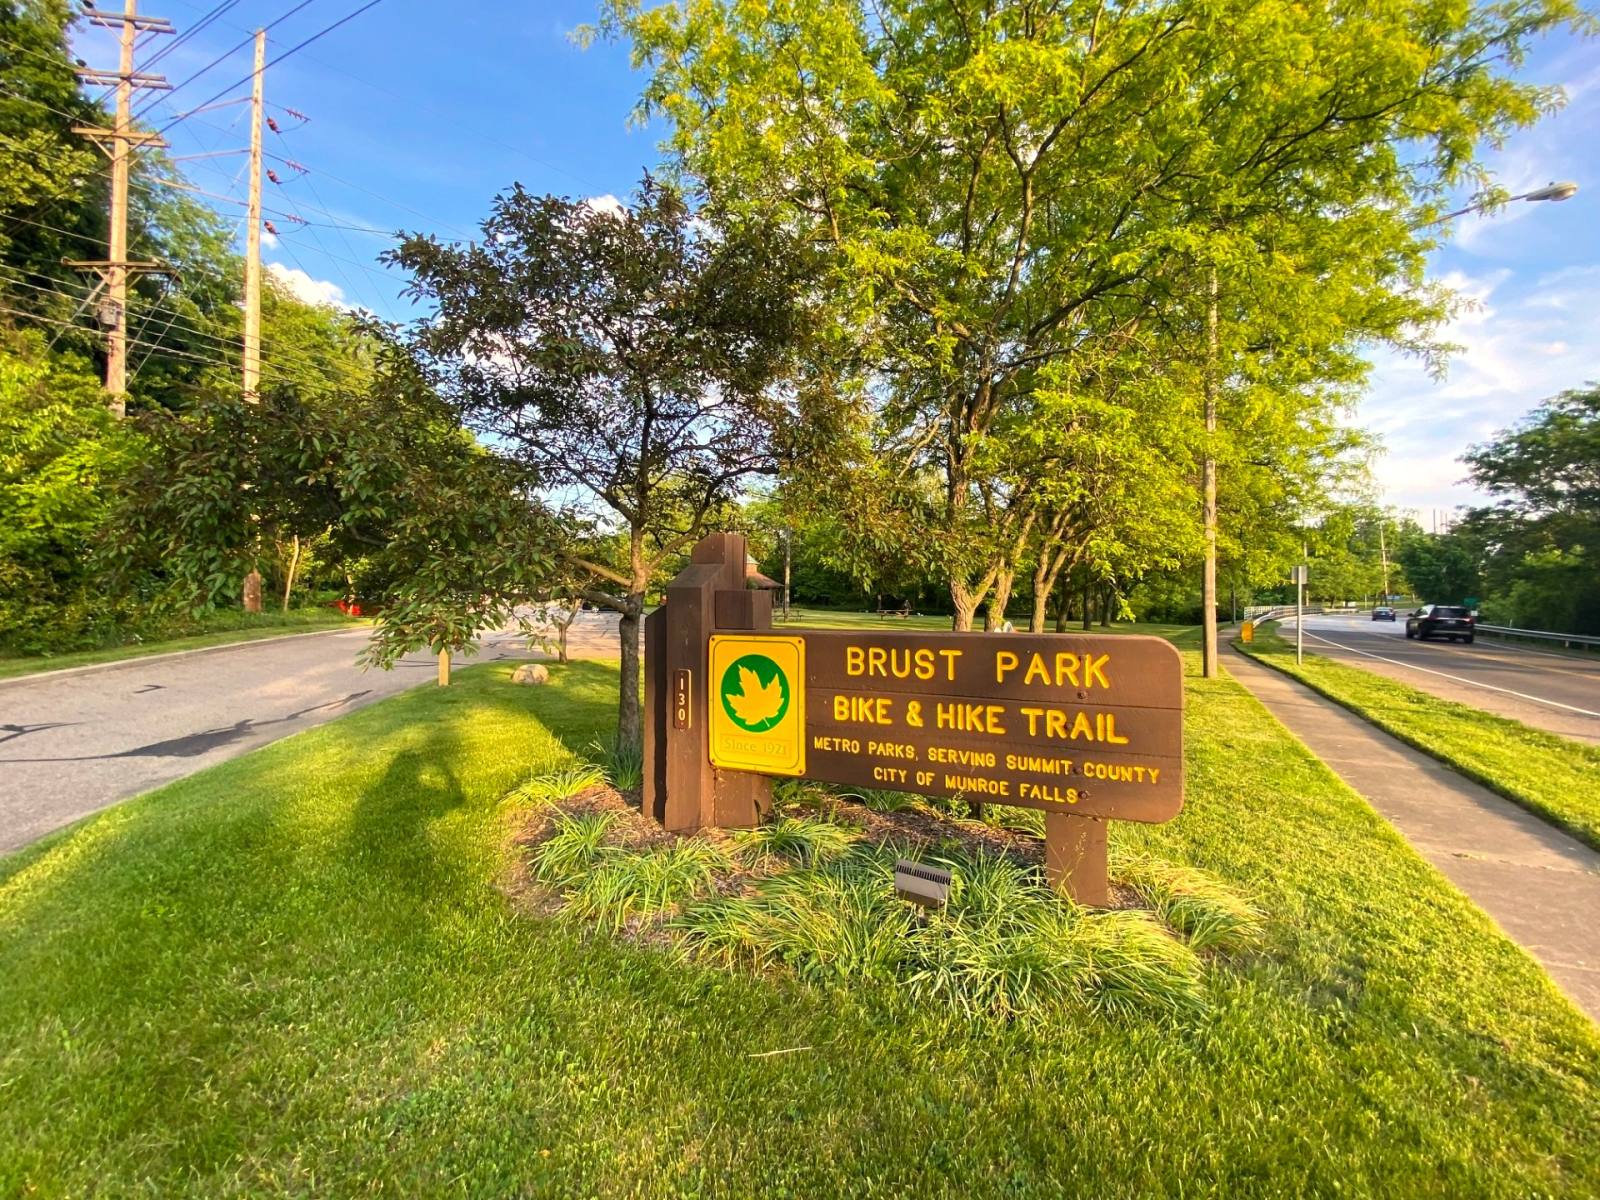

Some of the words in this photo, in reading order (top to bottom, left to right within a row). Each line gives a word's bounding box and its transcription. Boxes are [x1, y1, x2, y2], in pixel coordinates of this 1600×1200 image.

[846, 646, 963, 681] BRUST
[996, 651, 1111, 689] PARK
[678, 678, 686, 721] 130
[834, 695, 893, 725] BIKE
[906, 700, 924, 727] &
[937, 703, 1007, 734] HIKE
[1020, 708, 1129, 744] TRAIL
[814, 736, 860, 754] METRO
[868, 741, 919, 761] PARKS,
[928, 747, 996, 767] SERVING
[1006, 754, 1073, 775] SUMMIT
[1083, 762, 1160, 784] COUNTY
[873, 767, 907, 783] CITY
[916, 772, 935, 786] OF
[945, 774, 1009, 796] MUNROE
[1020, 783, 1079, 804] FALLS
